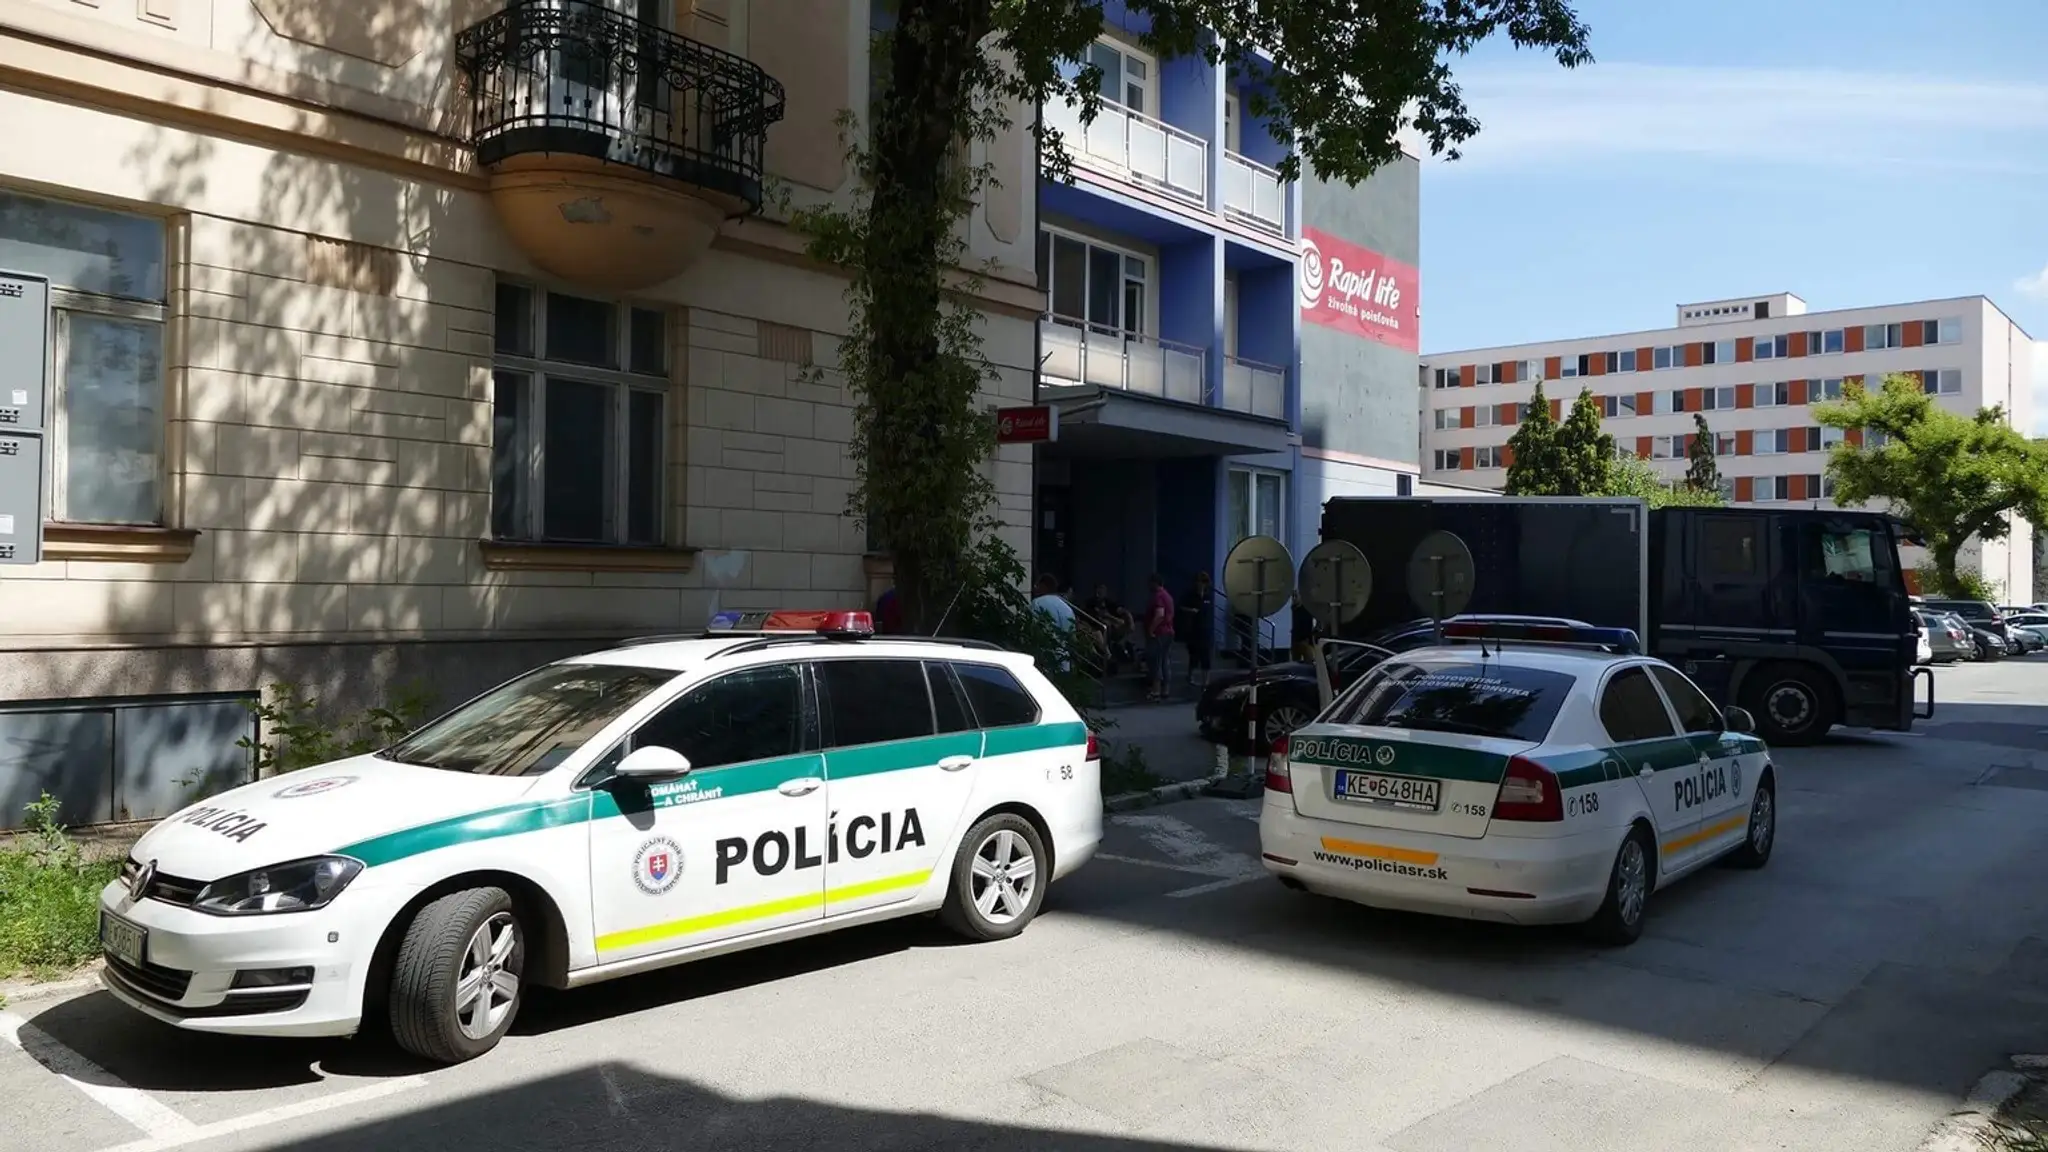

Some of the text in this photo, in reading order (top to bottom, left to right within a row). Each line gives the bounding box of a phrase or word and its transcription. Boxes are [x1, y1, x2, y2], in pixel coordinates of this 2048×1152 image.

[1328, 257, 1400, 310] Rapid life
[1328, 295, 1399, 329] životná poisťovňa
[1291, 739, 1372, 764] POLÍCIA
[664, 796, 673, 806] A
[1578, 792, 1599, 815] 158
[1674, 765, 1726, 812] POLÍCIA
[1464, 804, 1486, 817] 158
[715, 807, 926, 885] POLÍCIA
[1313, 850, 1448, 880] www.policiasr.sk
